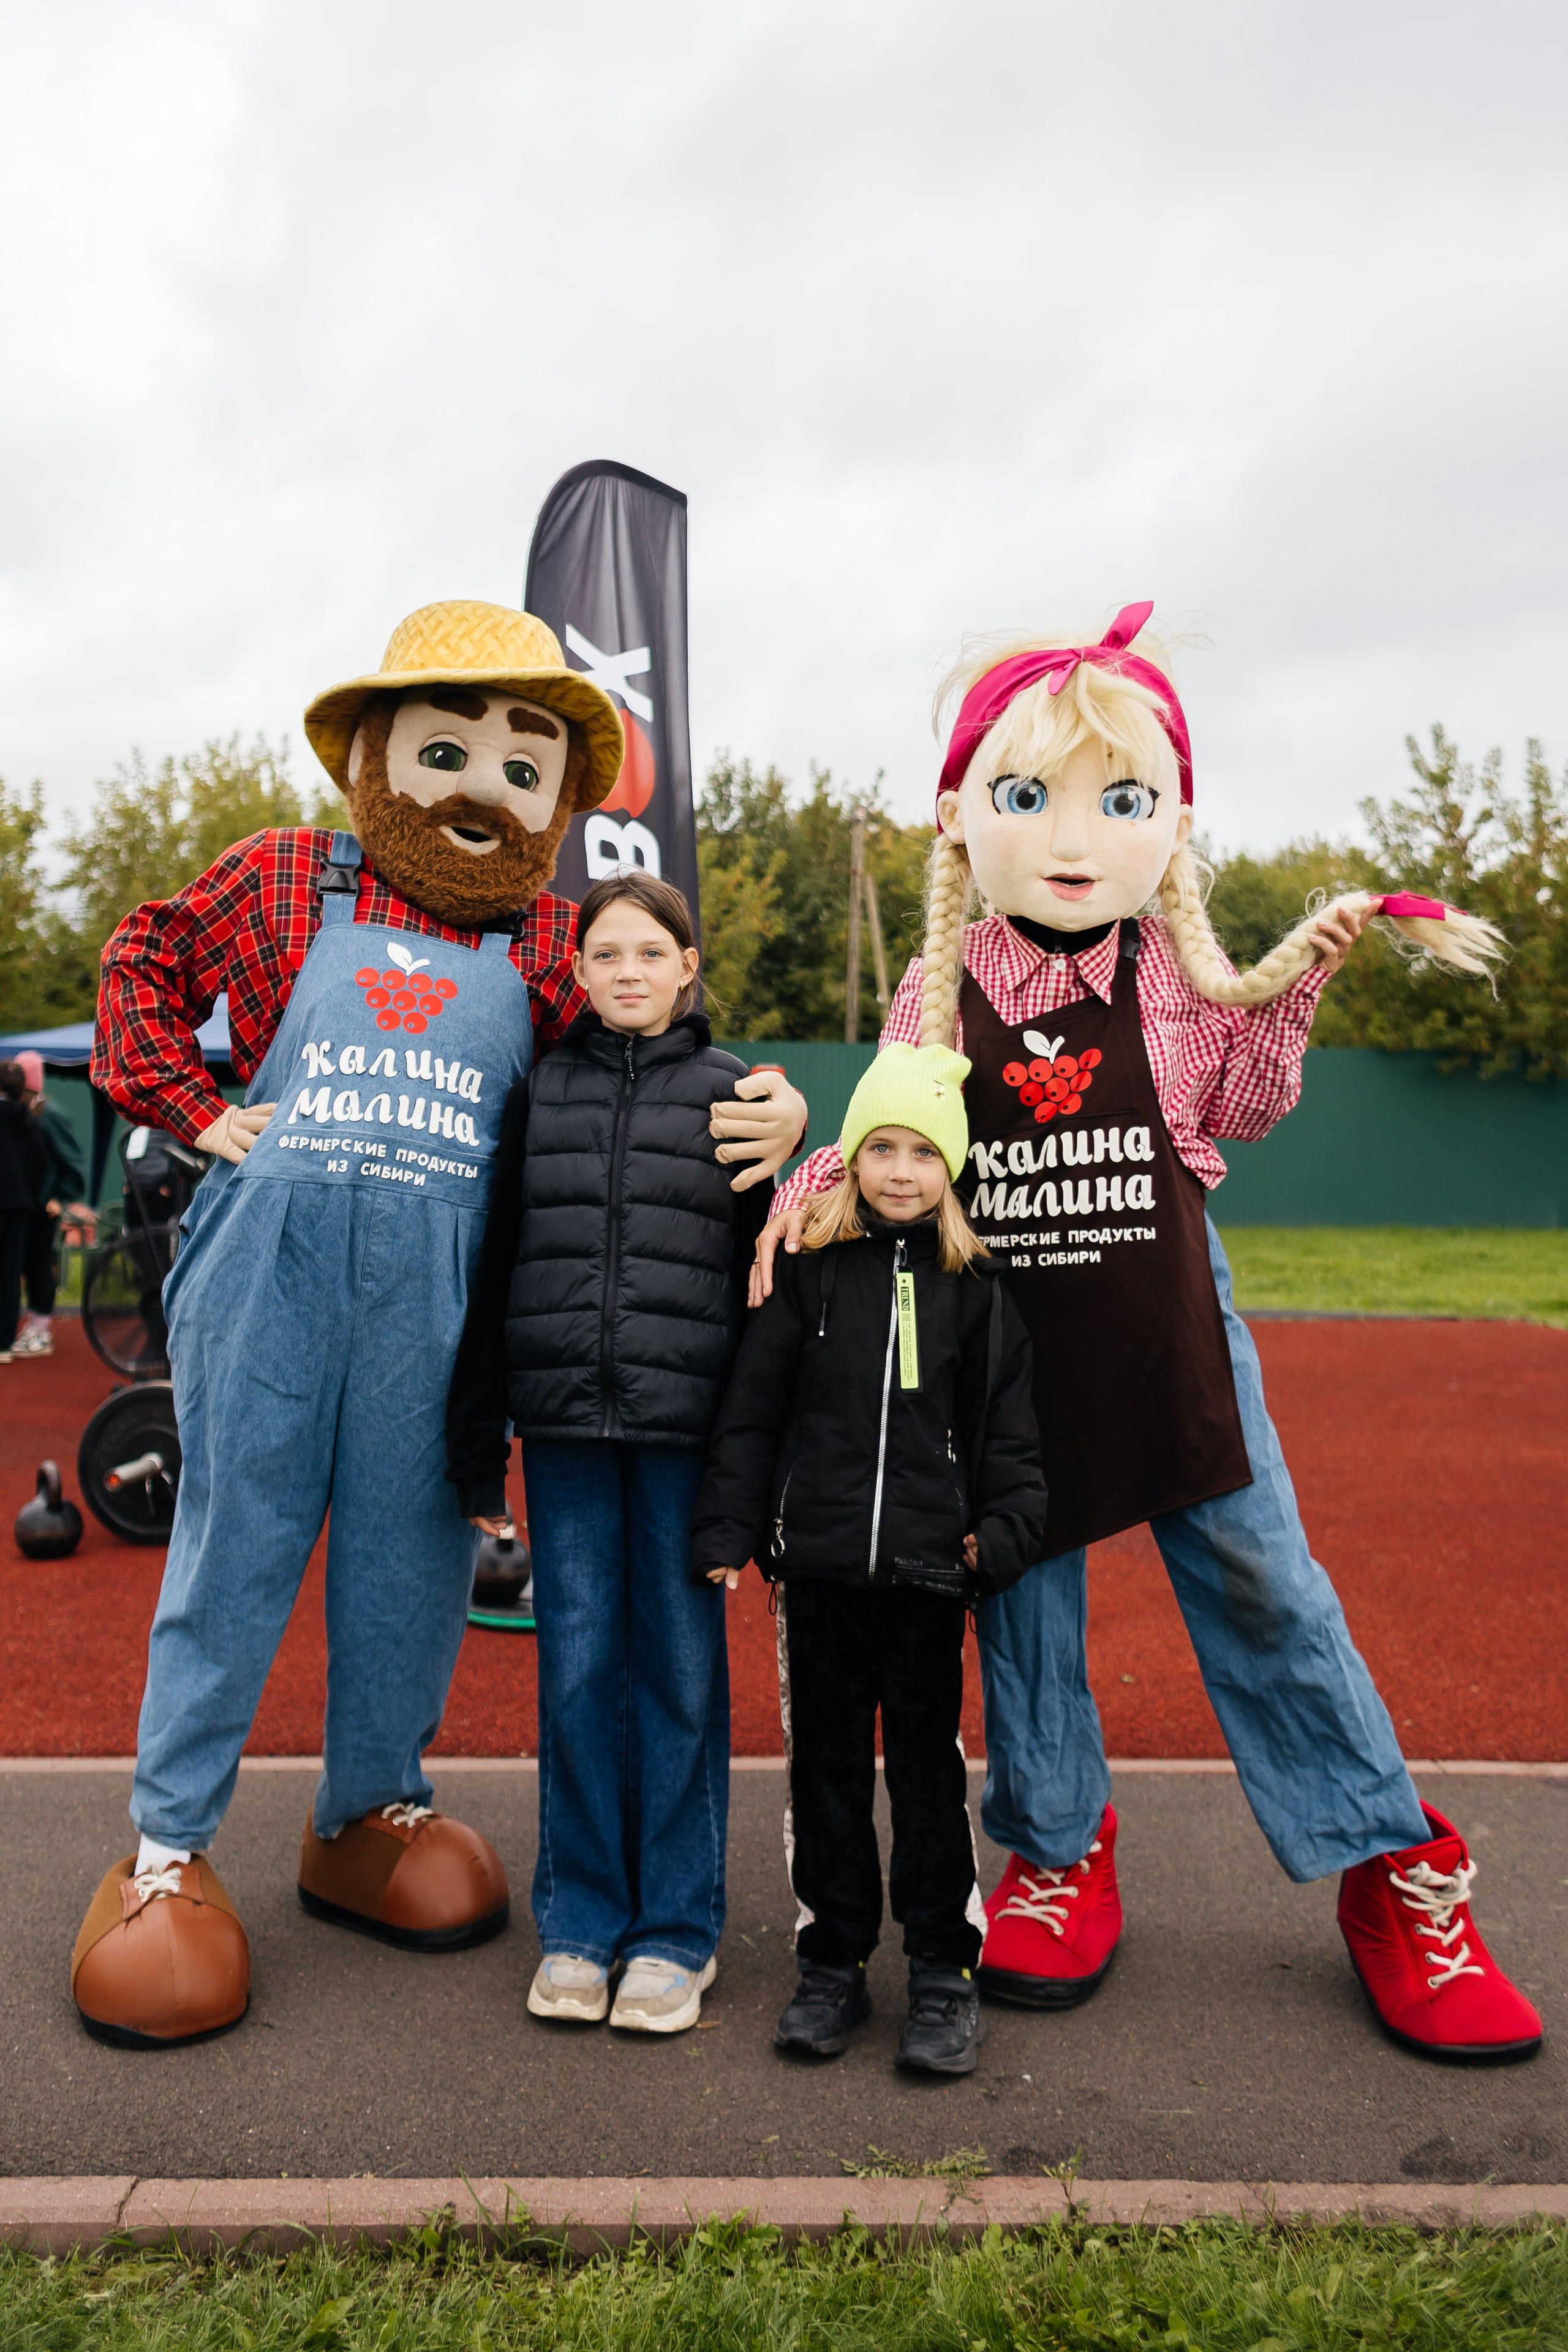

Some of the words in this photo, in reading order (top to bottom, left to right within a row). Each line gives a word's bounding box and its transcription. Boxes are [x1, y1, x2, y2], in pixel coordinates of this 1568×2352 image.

[278, 1135, 386, 1158] ФЕРМЕРСКИЕ
[395, 1148, 478, 1178] ПРОДУКТЫ
[326, 1159, 349, 1173] ИЗ
[360, 1162, 426, 1186] СИБИРИ
[978, 1231, 1060, 1248] ЕРМЕРСКИЕ
[1068, 1227, 1156, 1245] ПРОДУКТЫ
[1011, 1254, 1031, 1267] ИЗ
[1038, 1251, 1101, 1267] СИБИРИ
[901, 1287, 910, 1311] TREND
